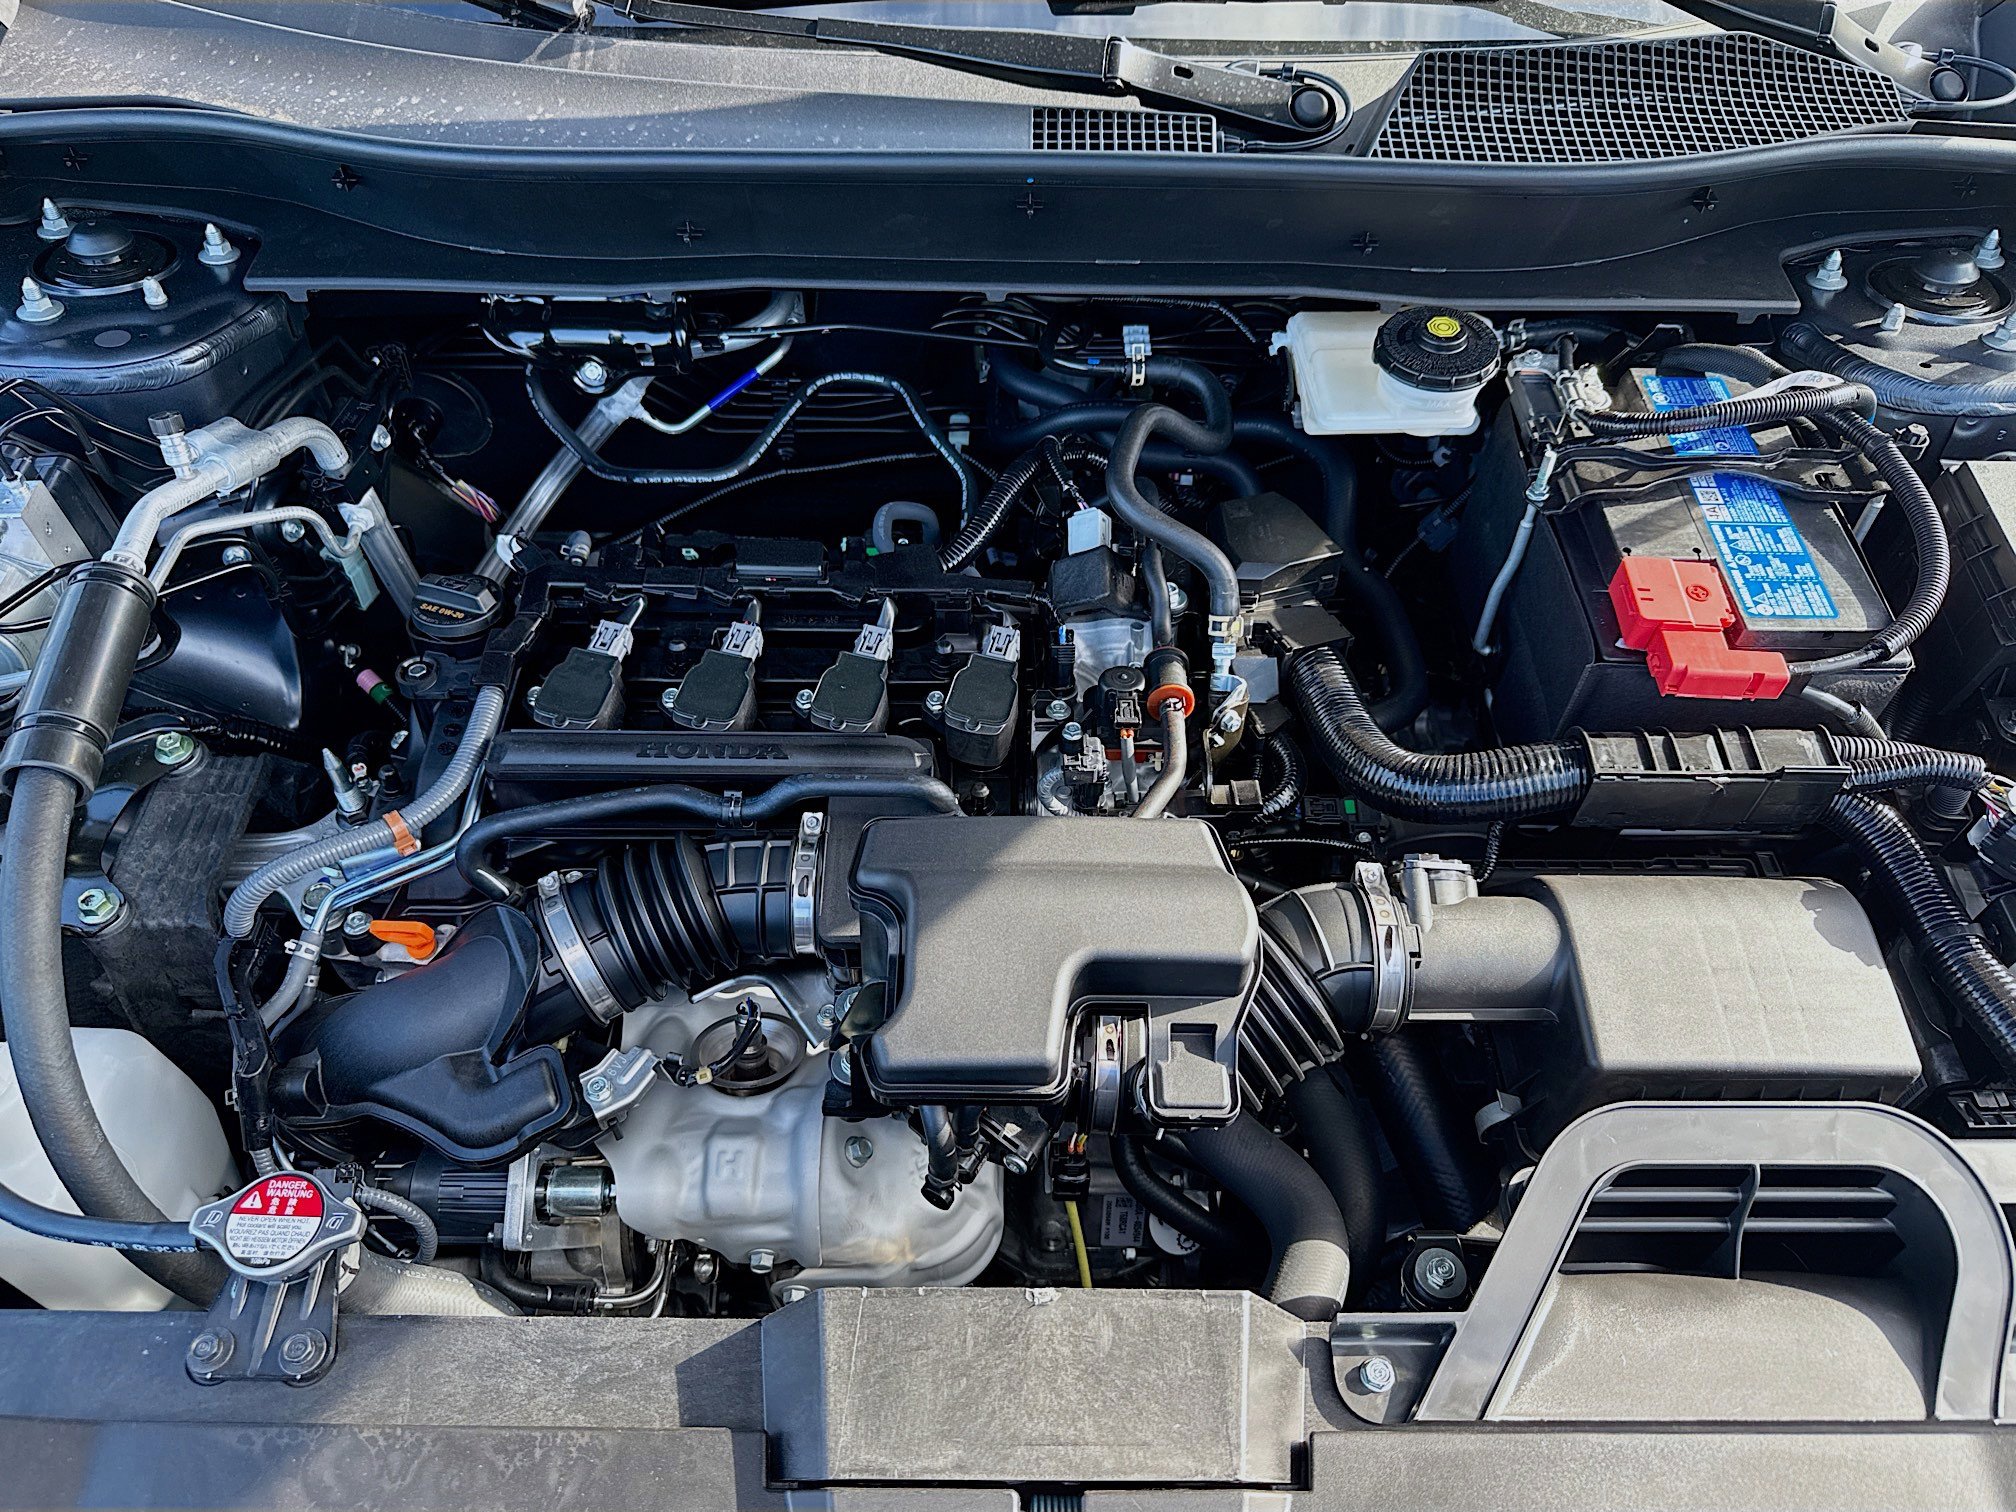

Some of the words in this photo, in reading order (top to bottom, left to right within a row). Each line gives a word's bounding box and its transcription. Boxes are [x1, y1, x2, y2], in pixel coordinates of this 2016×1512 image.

[420, 603, 440, 612] SAE
[438, 608, 465, 619] 0W-20
[635, 741, 790, 760] HONDA
[268, 1179, 307, 1190] DANGER
[266, 1188, 313, 1198] WARNUNG
